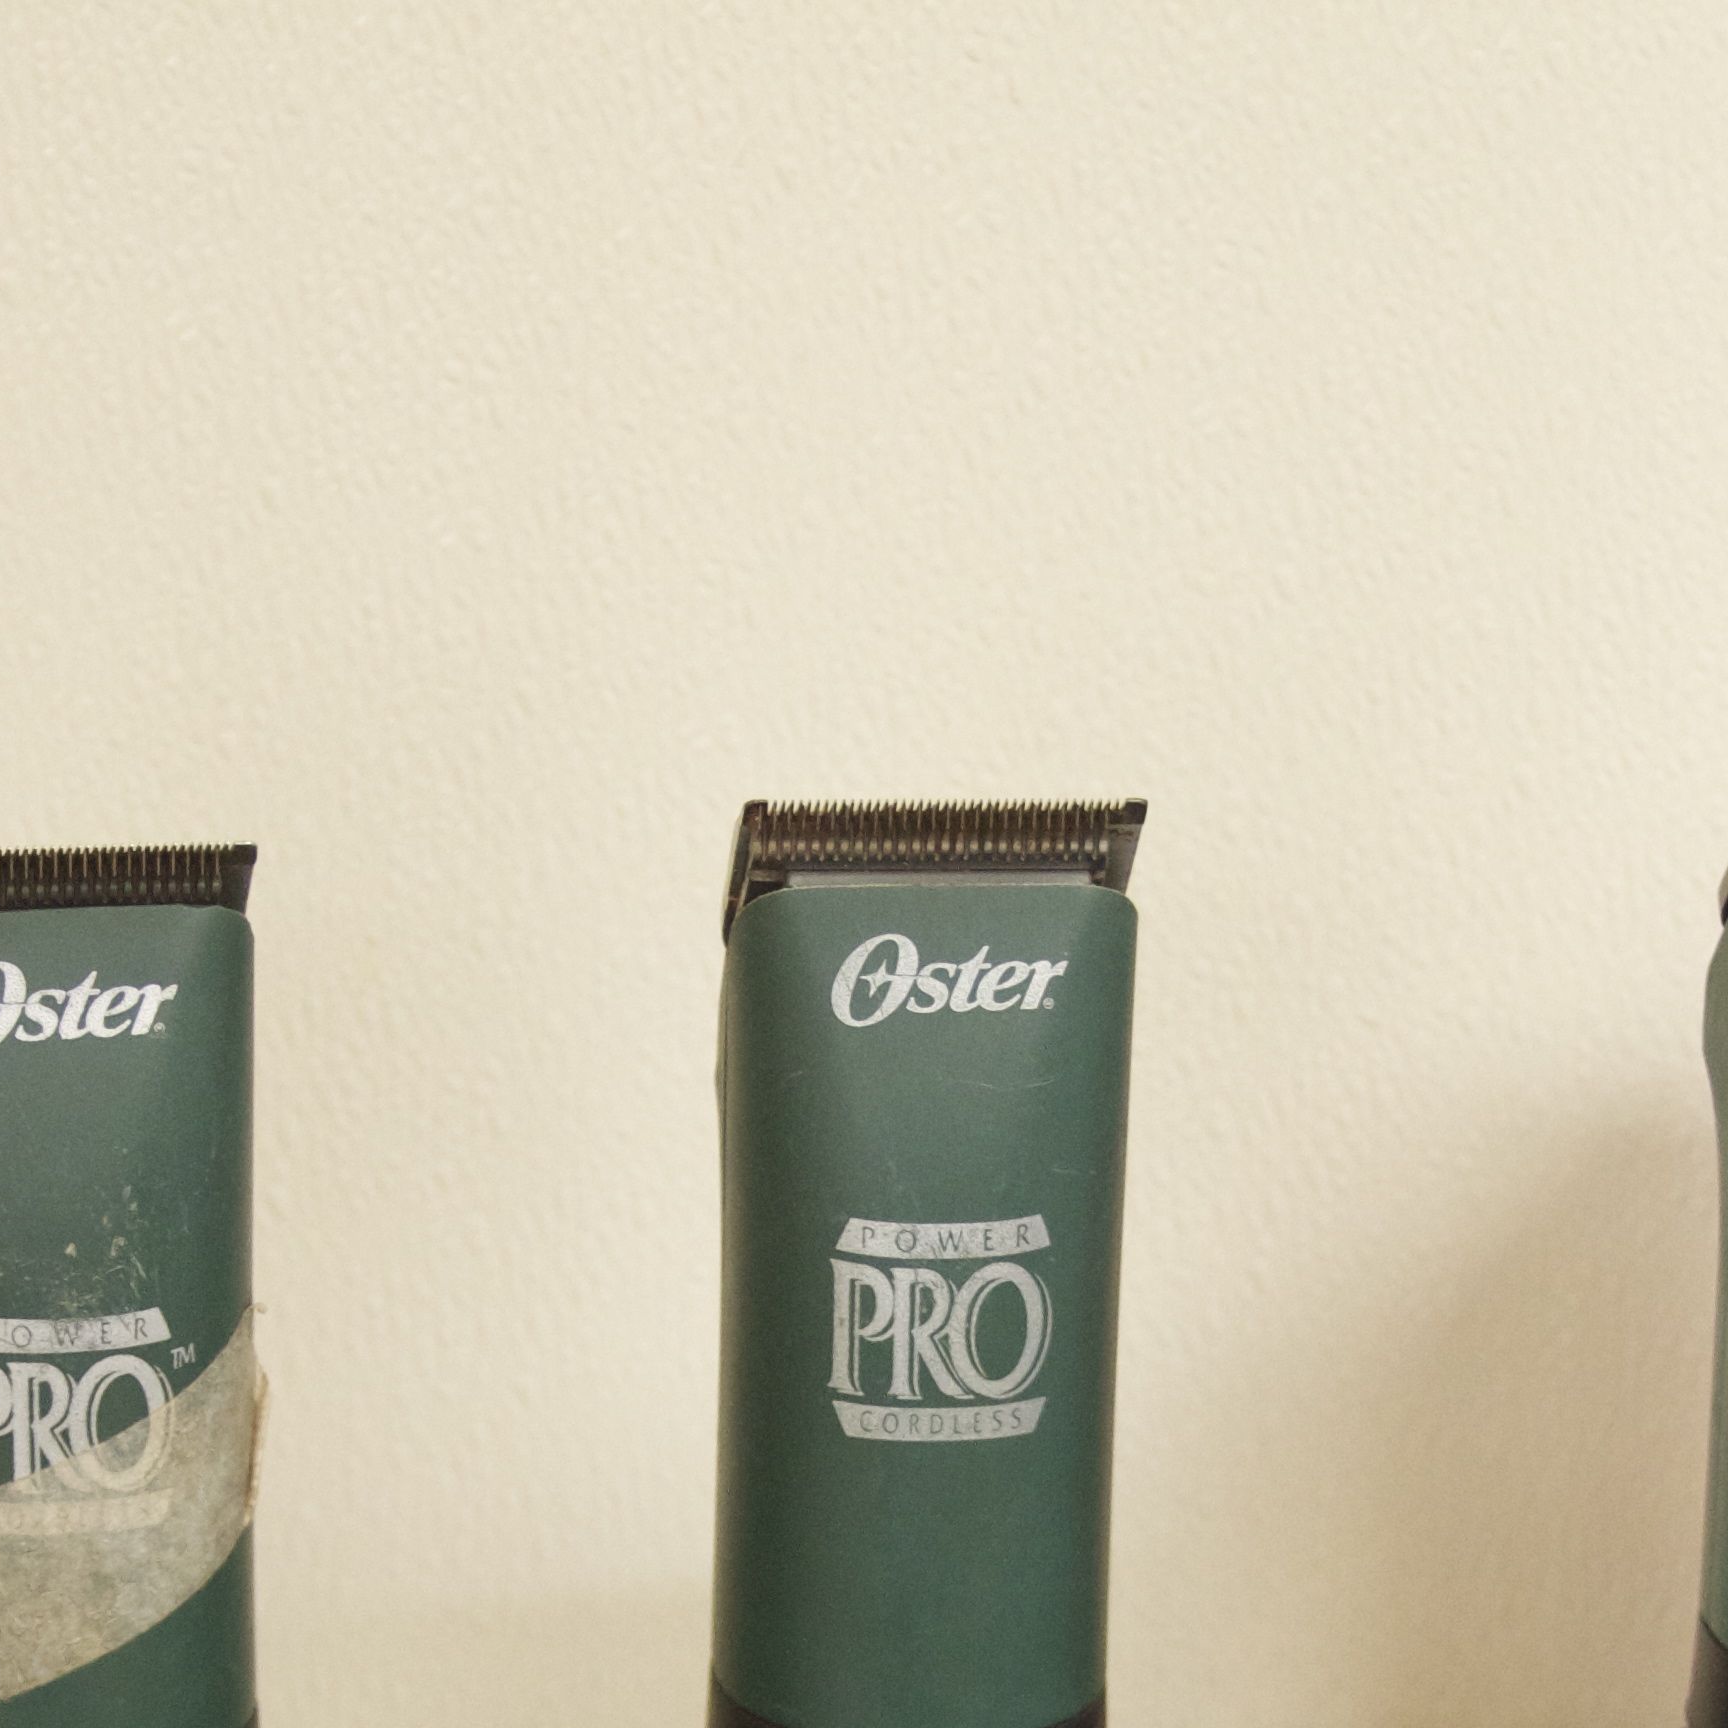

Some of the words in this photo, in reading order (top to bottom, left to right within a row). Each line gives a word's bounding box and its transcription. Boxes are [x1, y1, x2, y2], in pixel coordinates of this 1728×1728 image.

[831, 933, 1068, 1027] Oster
[862, 1224, 1030, 1252] POWER
[827, 1258, 1052, 1399] PRO
[860, 1408, 1021, 1434] CORDLESS
